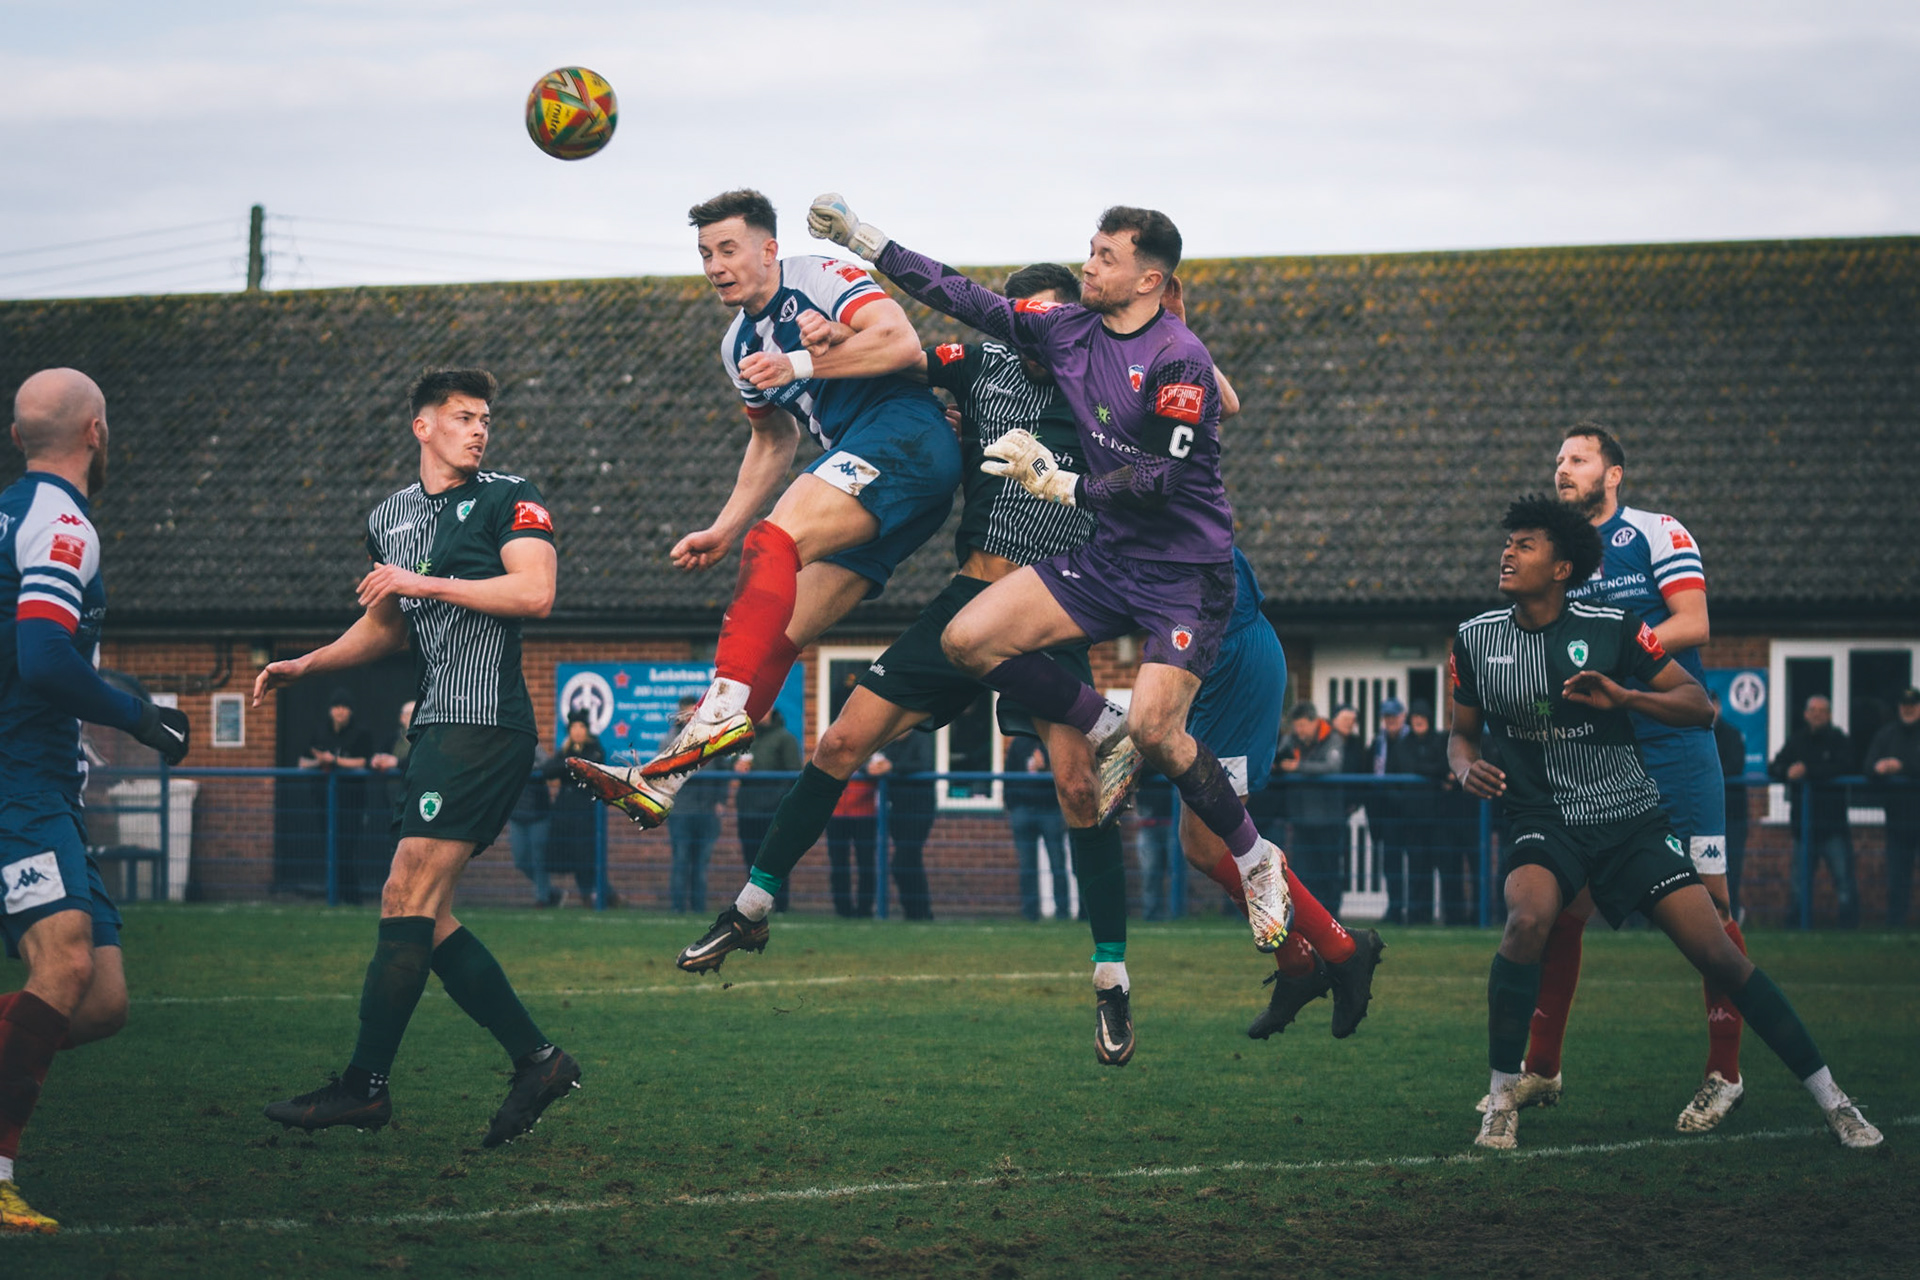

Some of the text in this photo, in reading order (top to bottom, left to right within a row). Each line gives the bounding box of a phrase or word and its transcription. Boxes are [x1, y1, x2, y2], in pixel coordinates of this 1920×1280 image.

[549, 103, 562, 136] mitre
[1168, 424, 1194, 459] C
[1592, 572, 1647, 593] FENCING
[1607, 587, 1650, 601] COMMERCIAL
[1506, 721, 1594, 741] Elliott Nash
